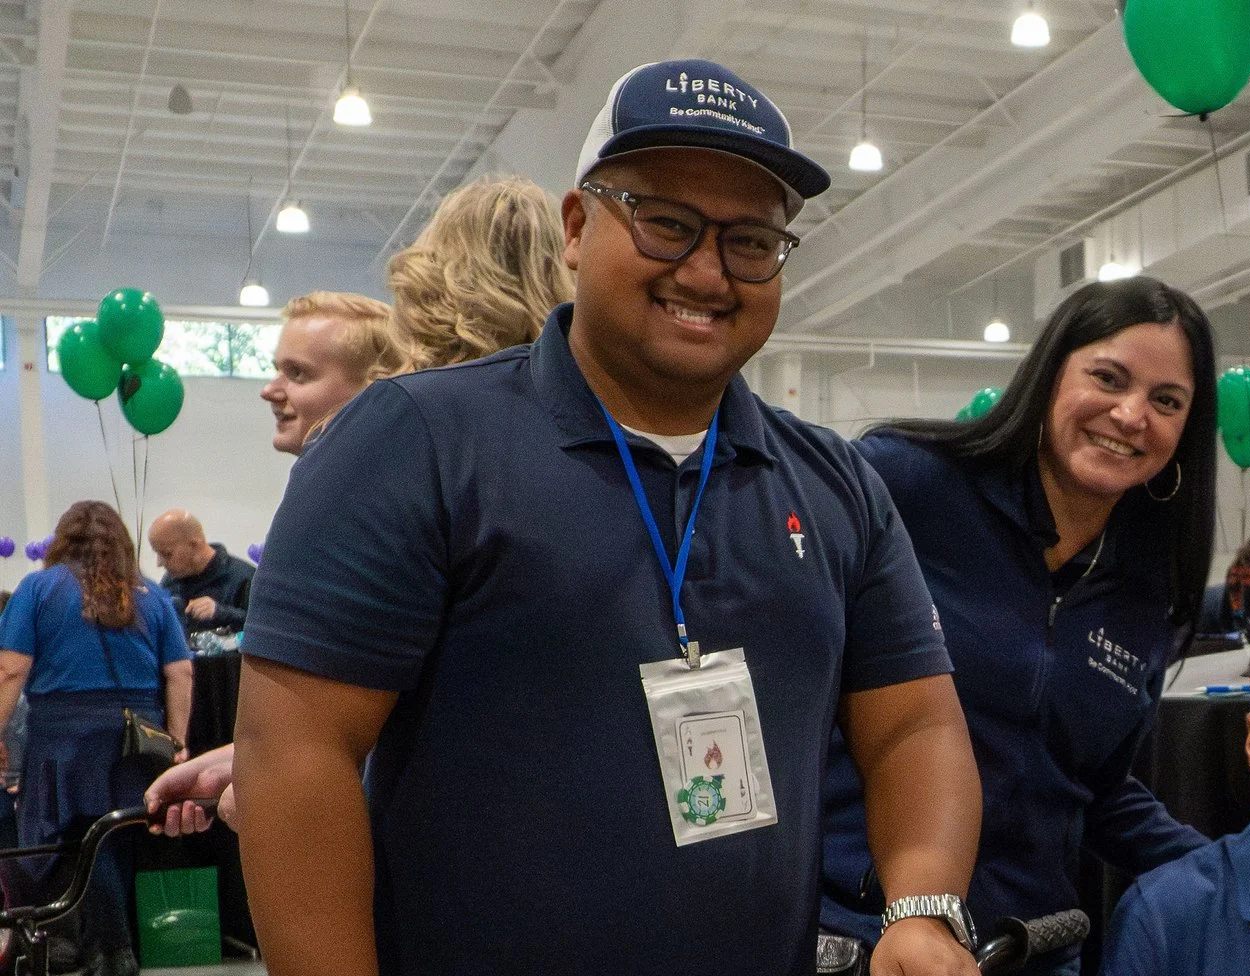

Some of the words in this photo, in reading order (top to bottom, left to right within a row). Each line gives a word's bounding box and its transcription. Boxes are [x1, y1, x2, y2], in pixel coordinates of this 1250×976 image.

[666, 72, 758, 108] LIBERTY
[697, 93, 737, 111] BANK
[669, 107, 684, 116] Be
[685, 108, 741, 126] Community
[1088, 627, 1147, 671] LIBERTY
[698, 795, 709, 807] 21
